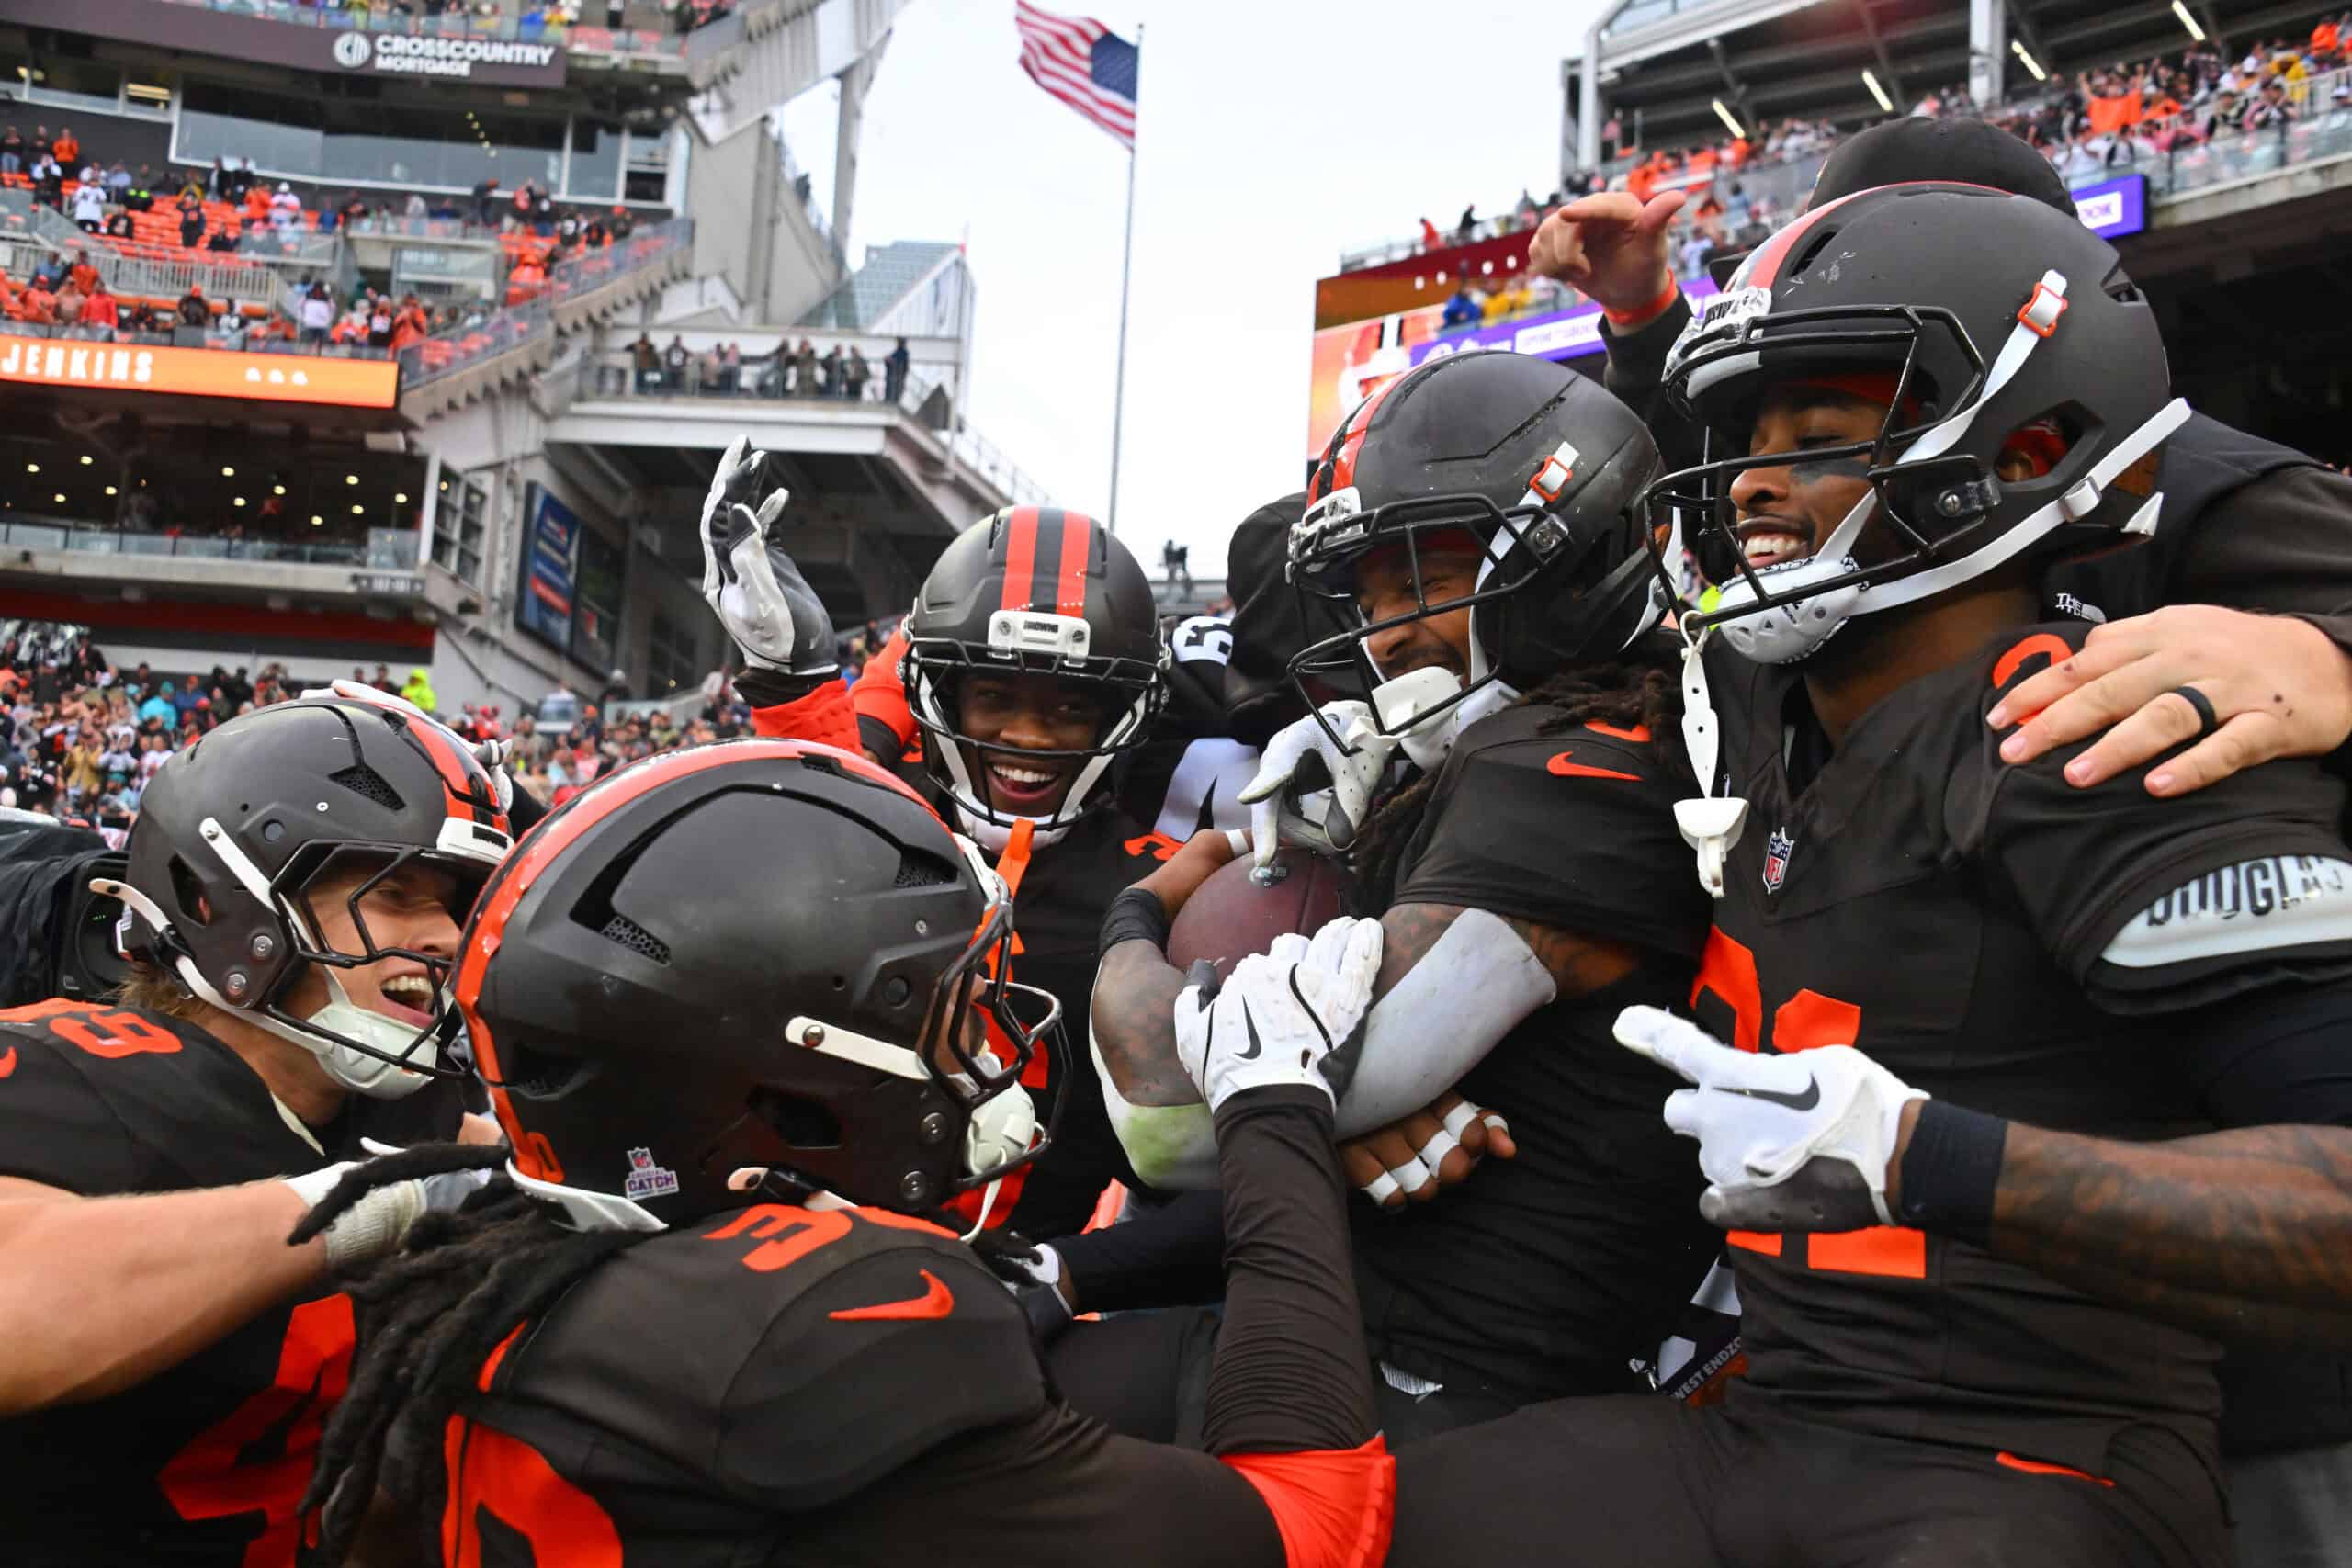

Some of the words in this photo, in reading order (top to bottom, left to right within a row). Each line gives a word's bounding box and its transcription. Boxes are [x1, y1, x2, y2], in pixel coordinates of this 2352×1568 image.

[375, 34, 555, 66] CROSSCOUNTRY
[374, 54, 472, 76] MORTGAGE
[1, 343, 154, 383] JENKINS
[628, 1173, 674, 1192] CATCH
